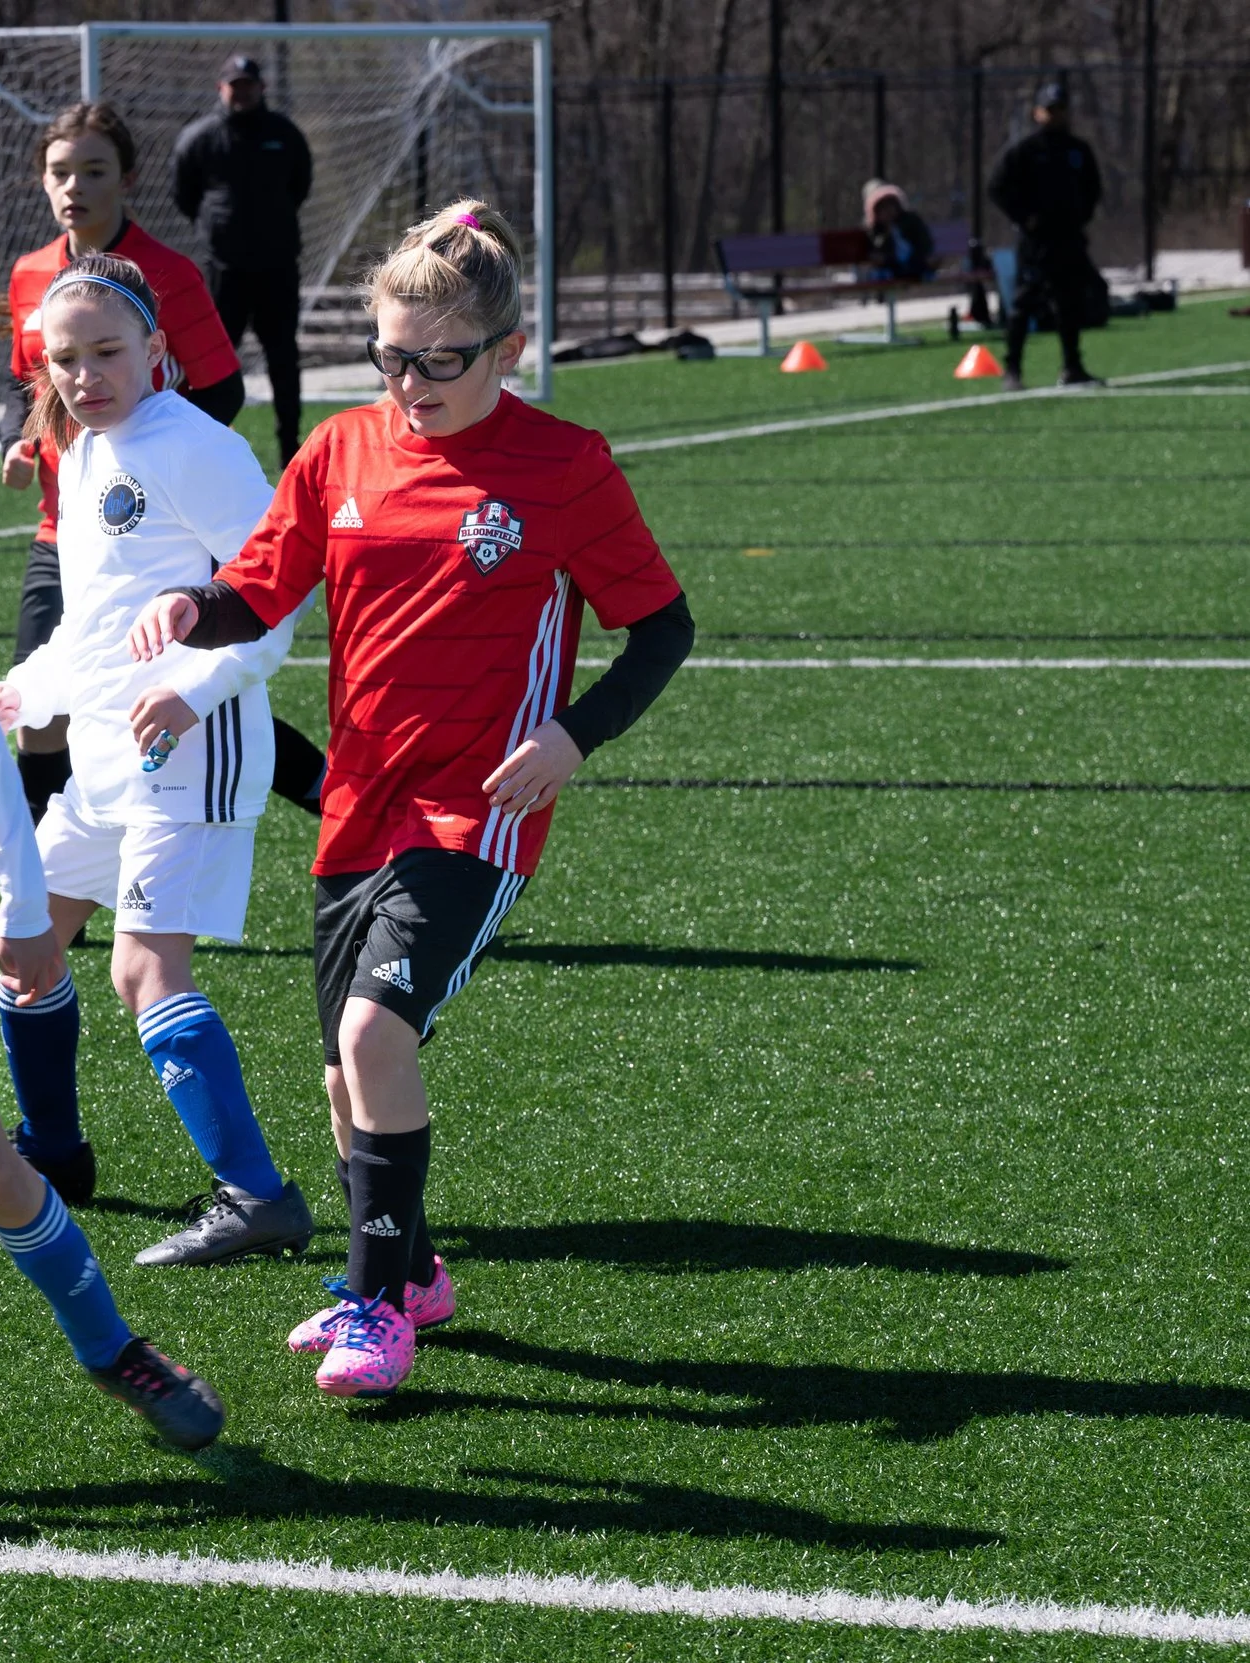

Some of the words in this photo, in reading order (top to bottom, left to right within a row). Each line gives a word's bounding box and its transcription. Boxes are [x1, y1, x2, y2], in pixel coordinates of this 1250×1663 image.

[121, 515, 140, 533] CLUB
[331, 517, 364, 529] adidas
[461, 527, 521, 545] BLOOMFIELD
[371, 967, 414, 994] adidas
[360, 1225, 402, 1237] adidas
